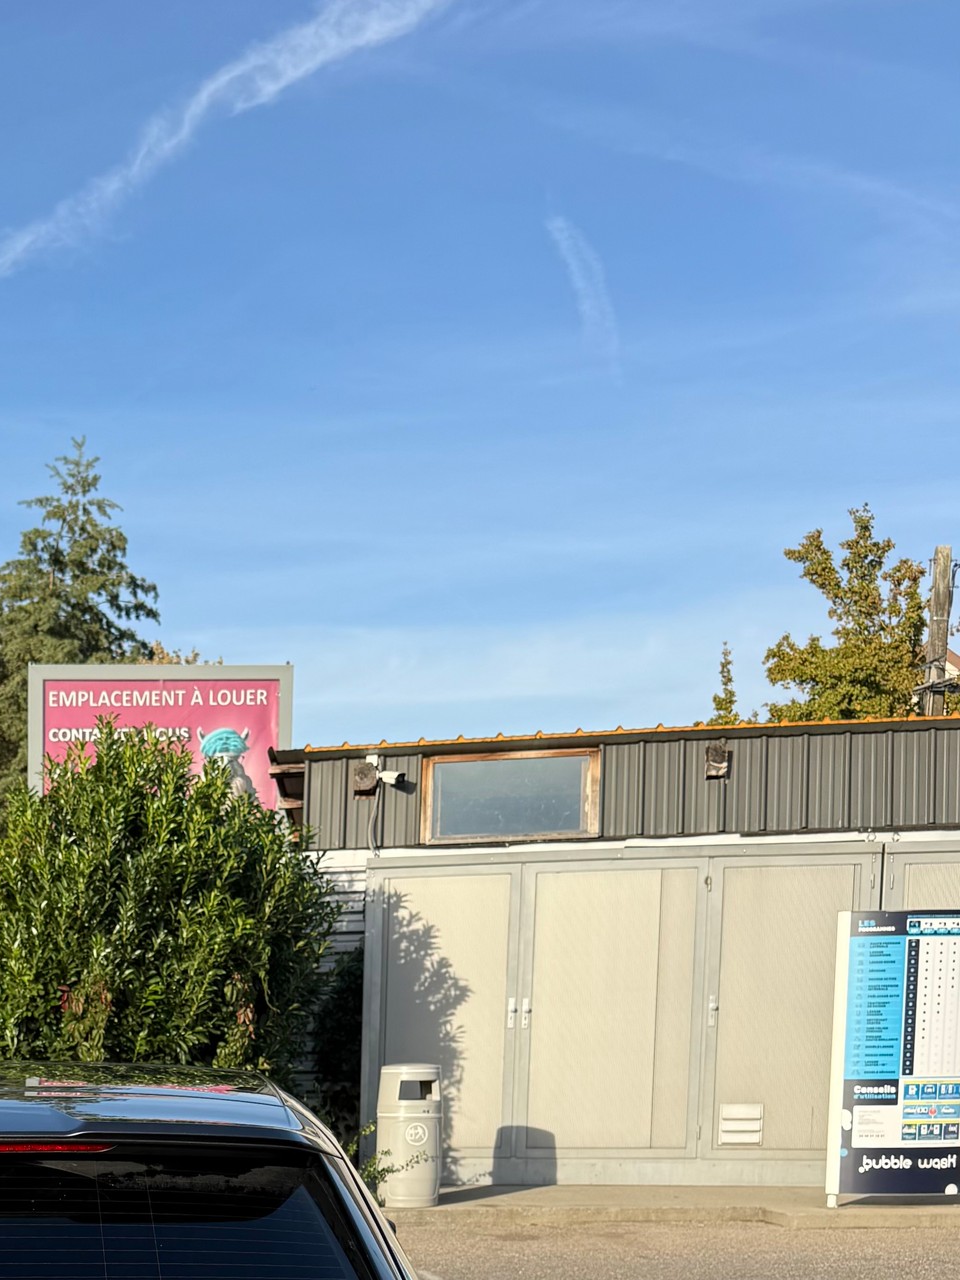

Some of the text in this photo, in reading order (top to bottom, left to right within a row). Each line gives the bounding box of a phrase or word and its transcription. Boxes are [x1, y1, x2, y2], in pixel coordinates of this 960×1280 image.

[48, 686, 268, 707] EMPLACEMENT À LOUER
[854, 1084, 897, 1094] Conseils
[860, 1154, 957, 1172] bubble wash
